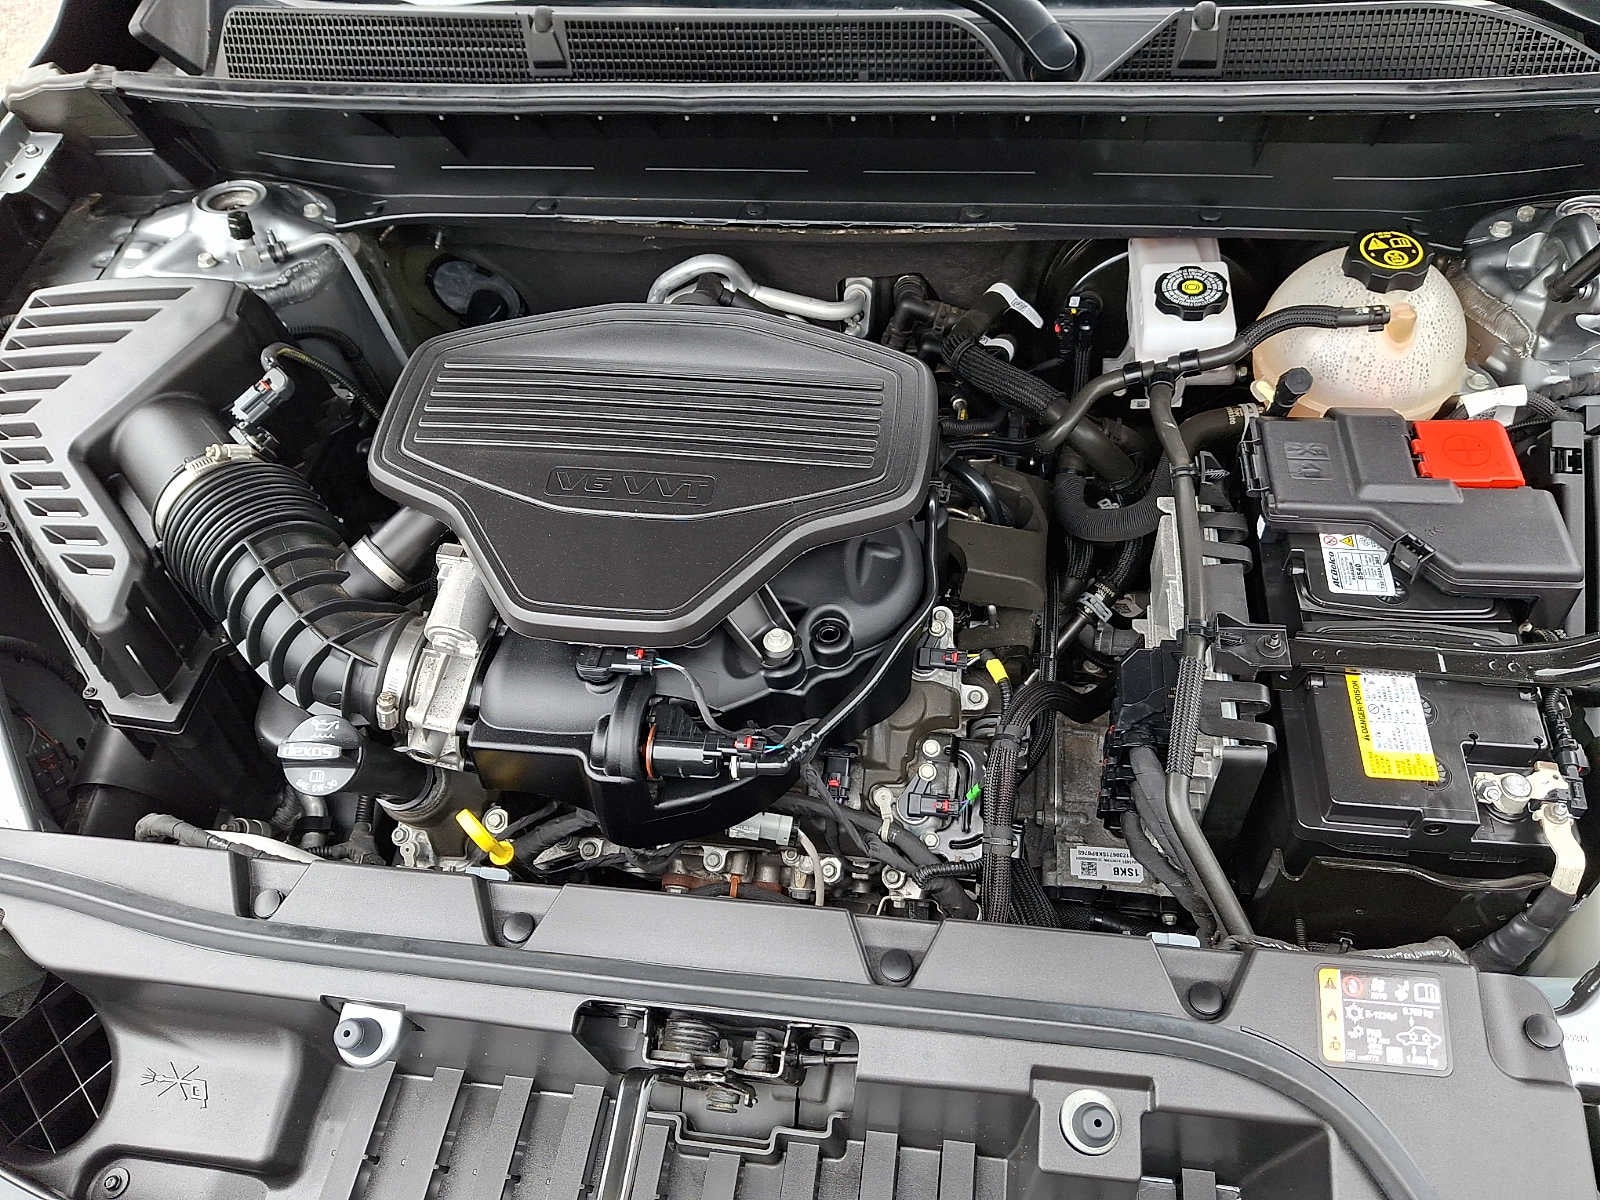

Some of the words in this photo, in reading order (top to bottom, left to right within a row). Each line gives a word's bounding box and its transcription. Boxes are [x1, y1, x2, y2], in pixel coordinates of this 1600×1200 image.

[556, 472, 612, 493] V6
[623, 475, 709, 499] VVT
[1328, 552, 1341, 588] ACDelco
[1113, 867, 1139, 877] 1SKB
